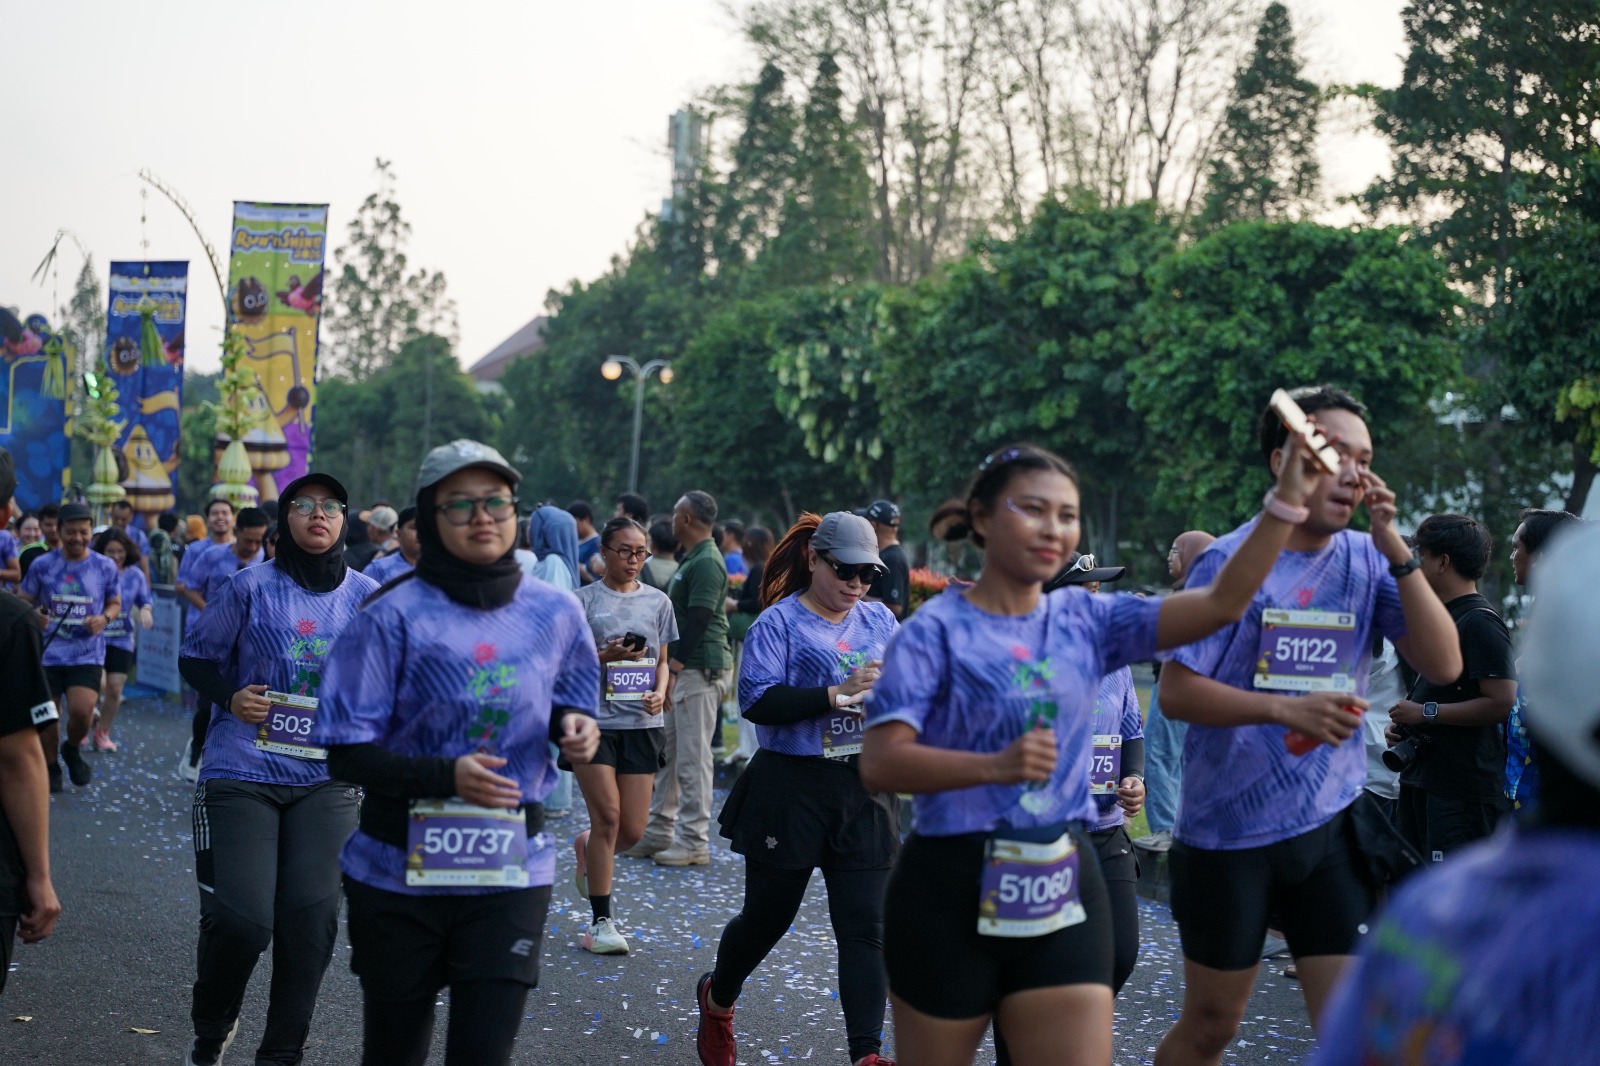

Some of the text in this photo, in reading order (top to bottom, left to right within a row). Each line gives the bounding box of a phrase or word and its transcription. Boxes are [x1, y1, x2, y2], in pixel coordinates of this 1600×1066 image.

[56, 603, 87, 616] 5246
[1275, 636, 1337, 663] 51122
[613, 672, 651, 686] 50754
[271, 713, 315, 735] 503
[424, 827, 516, 855] 50737
[999, 866, 1073, 904] 51060
